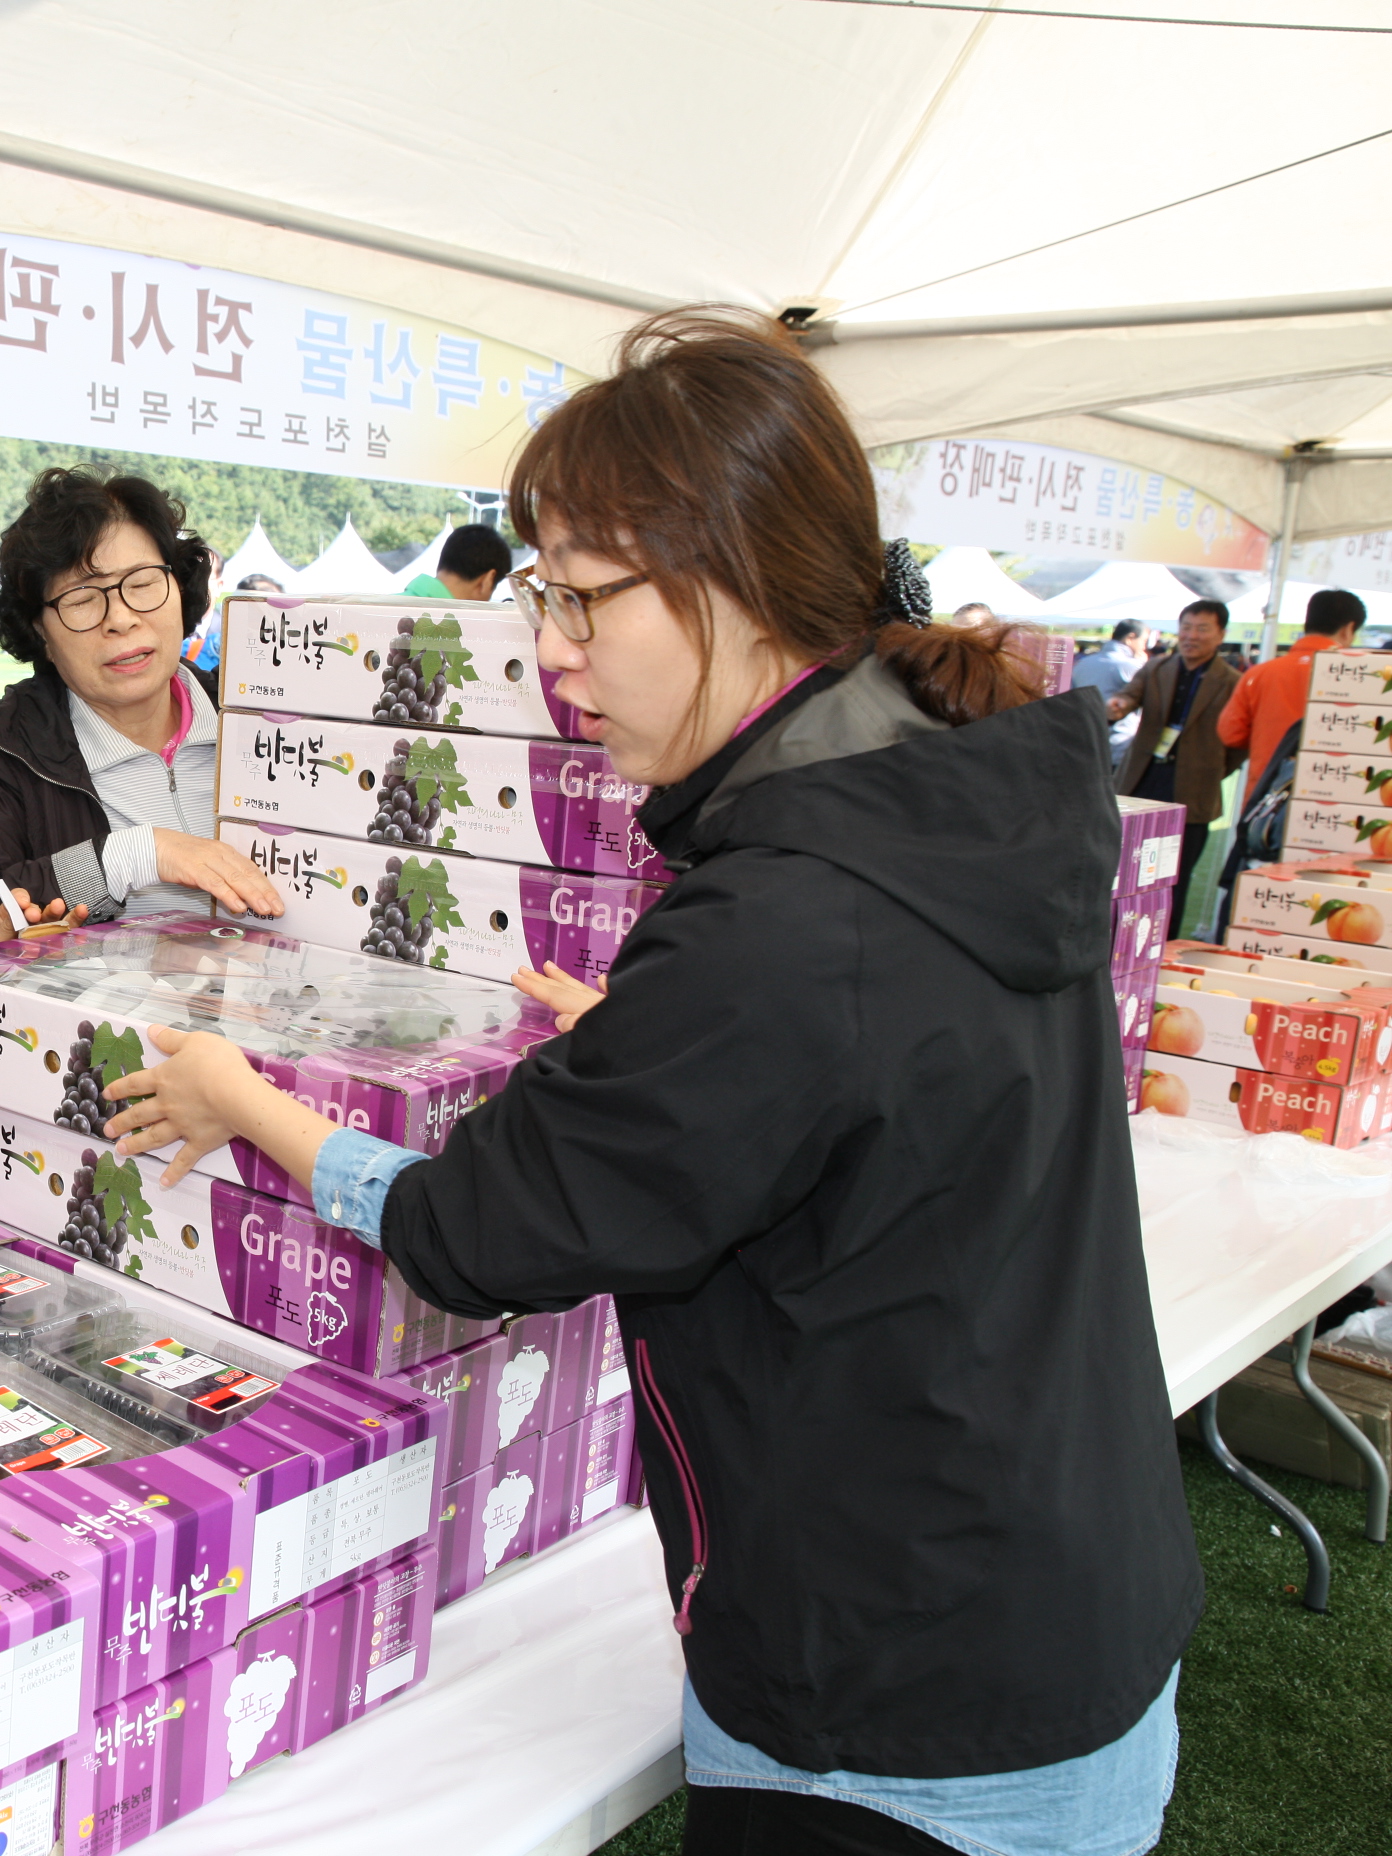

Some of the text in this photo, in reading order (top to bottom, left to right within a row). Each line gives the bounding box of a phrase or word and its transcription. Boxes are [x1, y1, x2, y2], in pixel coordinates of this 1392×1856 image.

[248, 684, 285, 698] 구천동농협
[558, 759, 649, 807] Grap
[244, 796, 279, 812] 구천동농협
[583, 821, 623, 854] 포도
[549, 886, 639, 945] Grap
[1272, 1014, 1349, 1046] Peach
[1256, 1083, 1332, 1115] Peach
[239, 1212, 353, 1290] Grape
[264, 1283, 304, 1327] 포도
[313, 1305, 337, 1331] 5kg
[504, 1379, 536, 1407] 포도
[489, 1505, 521, 1531] 포도
[122, 1563, 238, 1655] 반딧불
[103, 1635, 133, 1666] 무주
[236, 1691, 276, 1724] 포도
[94, 1698, 185, 1767] 반딧불
[80, 1752, 103, 1775] 무주
[96, 1786, 153, 1826] 구천동농협
